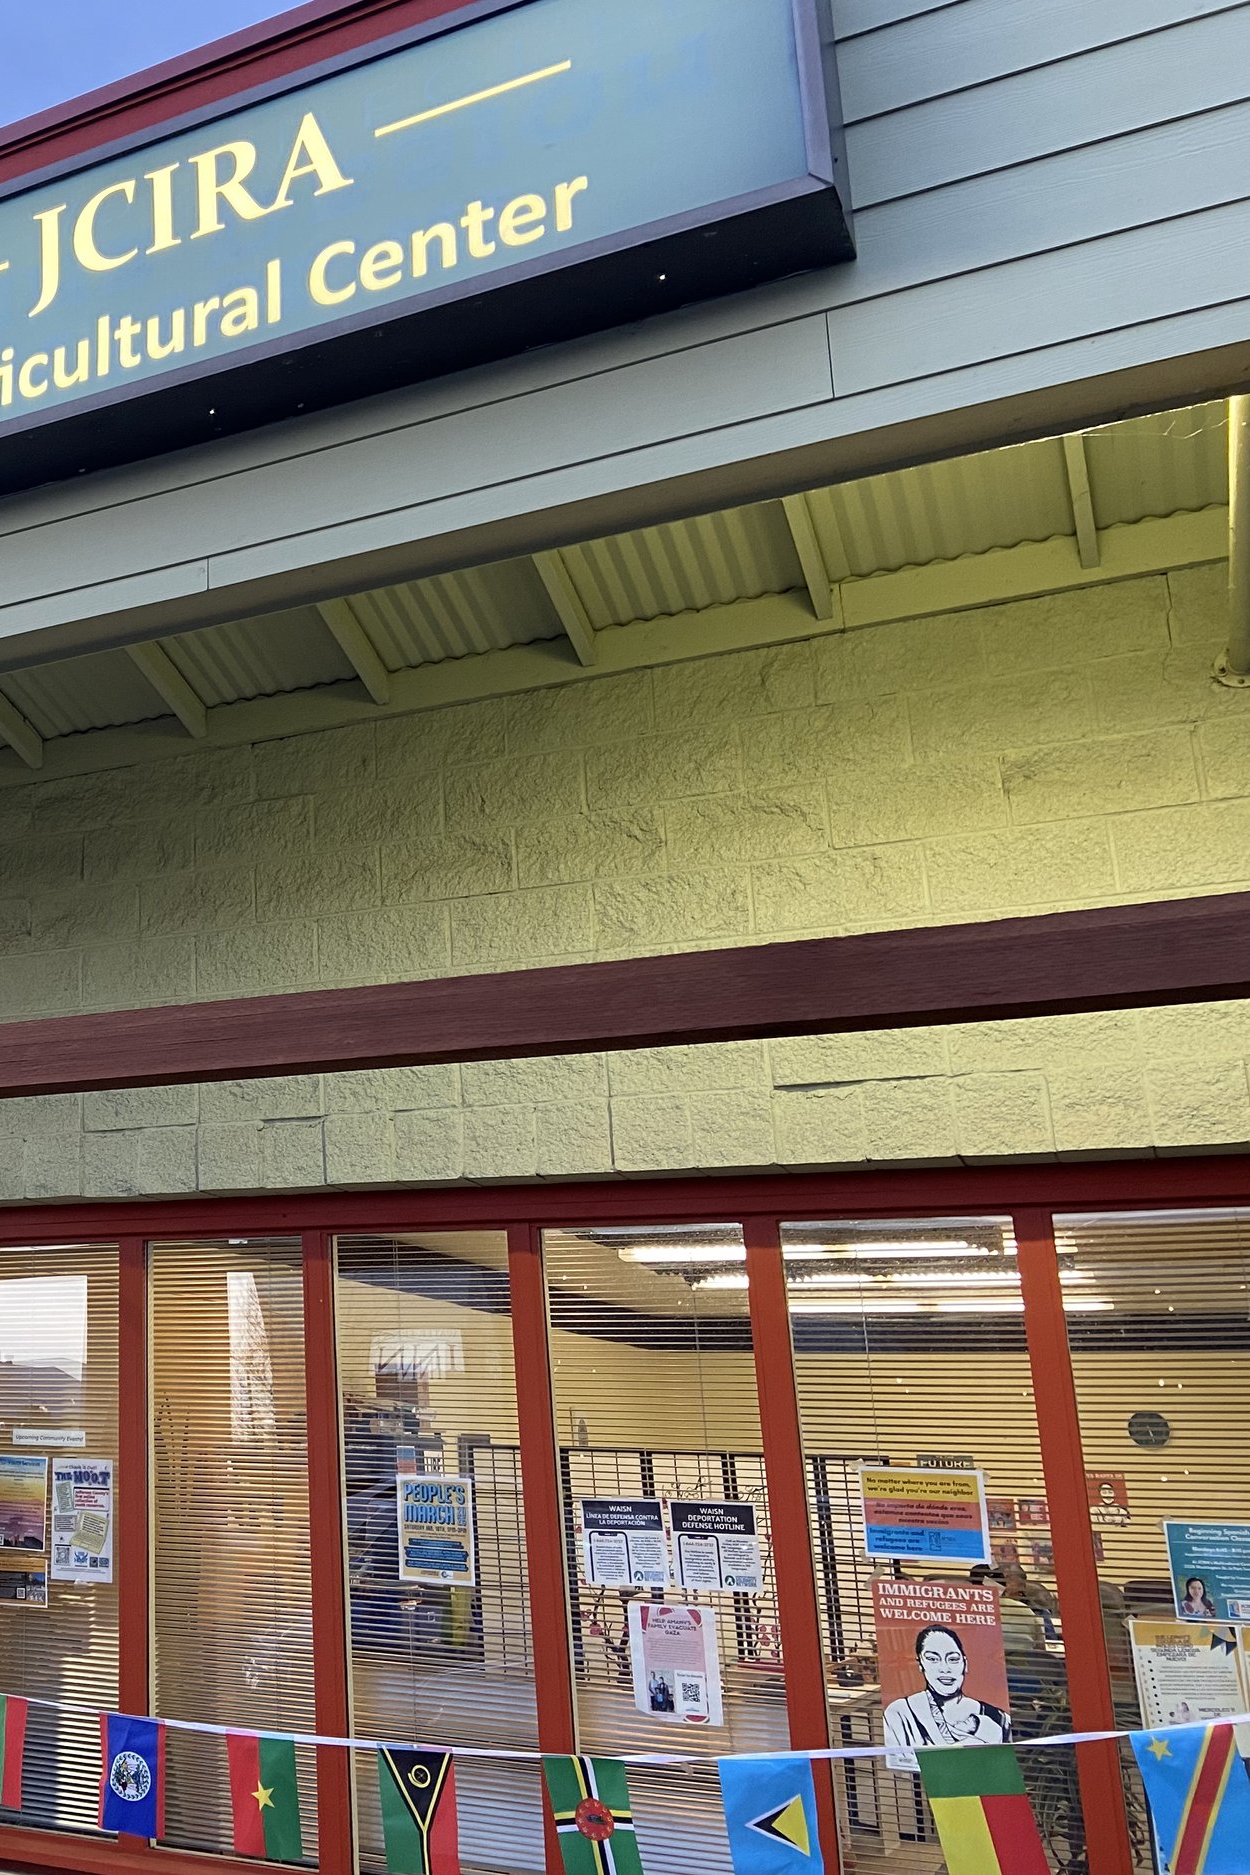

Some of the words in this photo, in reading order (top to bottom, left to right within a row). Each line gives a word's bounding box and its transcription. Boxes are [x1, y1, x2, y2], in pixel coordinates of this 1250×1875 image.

[28, 111, 353, 317] JCIRA
[308, 173, 588, 305] Center
[54, 1471, 73, 1481] THE
[902, 1478, 924, 1486] where
[952, 1480, 971, 1488] from,
[404, 1483, 466, 1505] PEOPLE'S
[888, 1485, 905, 1494] glad
[906, 1487, 928, 1495] you're
[942, 1488, 973, 1497] neighbor
[404, 1503, 456, 1525] MARCH
[699, 1507, 724, 1515] WAISN
[687, 1514, 738, 1523] DEPORTATION
[682, 1521, 713, 1529] DEFENSE
[713, 1523, 746, 1531] HOTLINE
[869, 1527, 910, 1536] Immigrants
[1188, 1527, 1222, 1537] Beginning
[875, 1536, 906, 1545] refugees
[1185, 1533, 1229, 1541] Conversation
[873, 1543, 906, 1551] welcome
[877, 1583, 994, 1601] IMMIGRANTS
[879, 1597, 904, 1606] AND
[906, 1599, 967, 1611] REFUGEES
[970, 1604, 995, 1613] ARE
[879, 1608, 952, 1622] WELCOME
[955, 1613, 996, 1625] HERE
